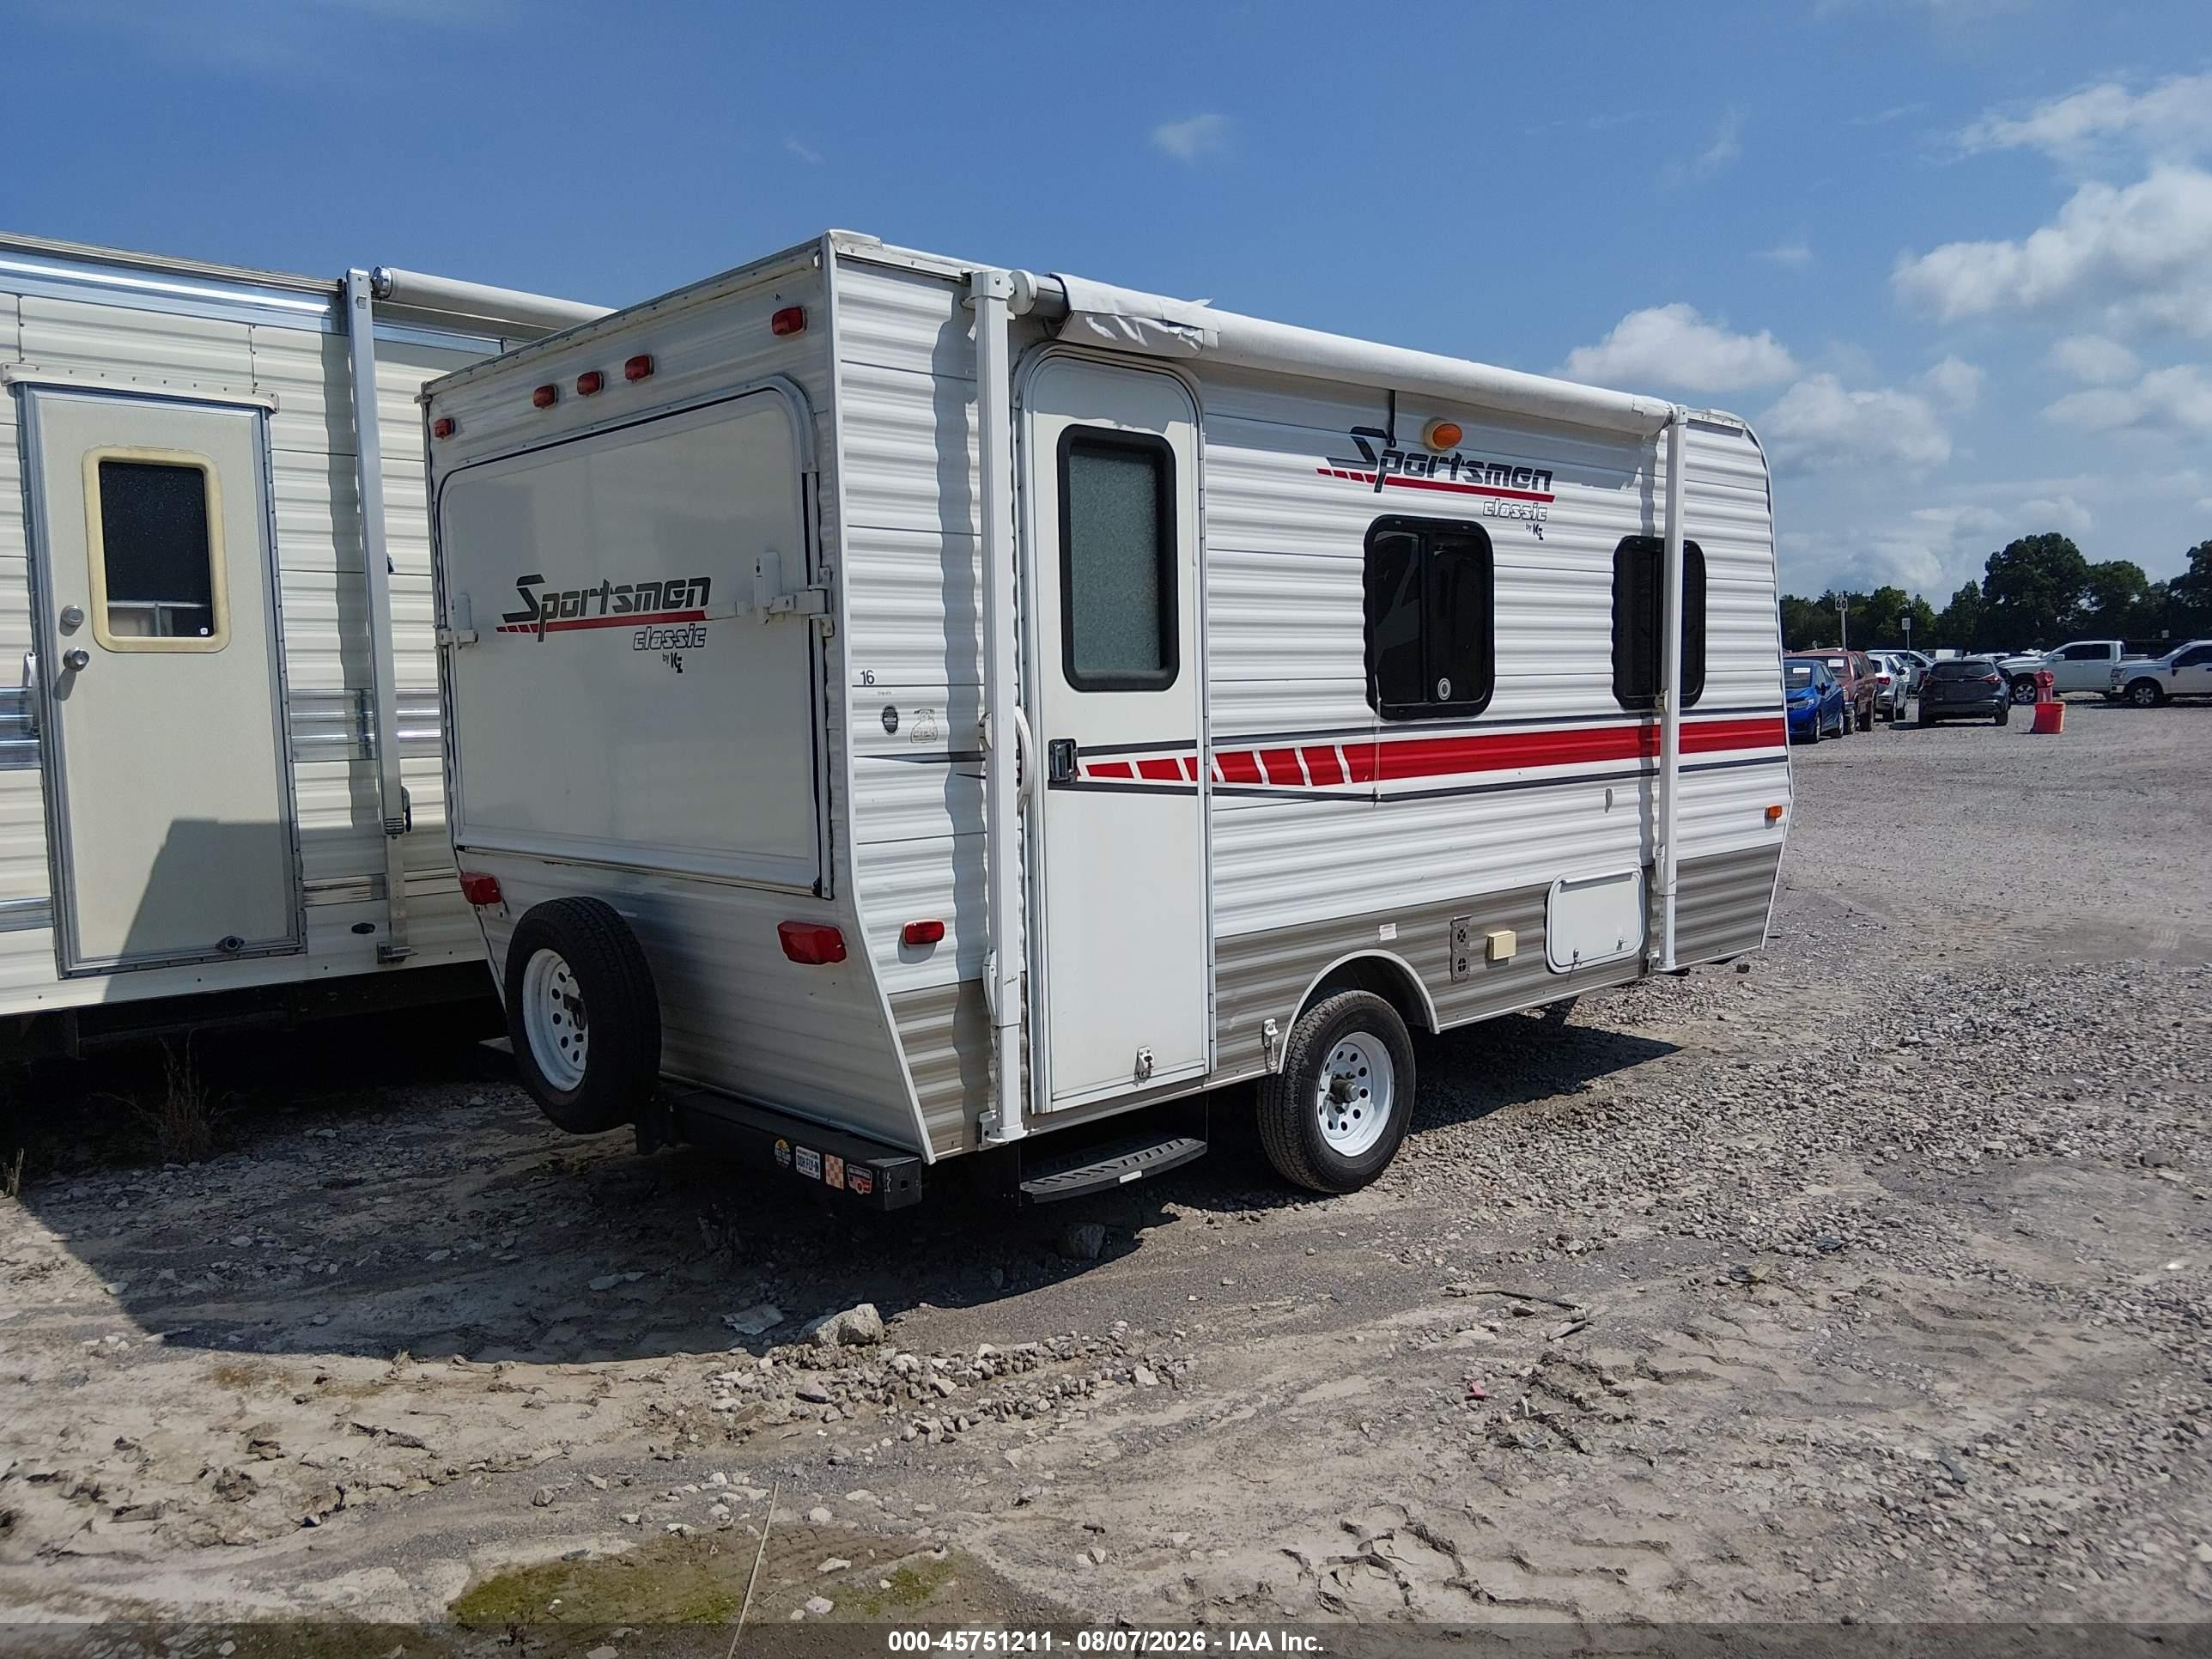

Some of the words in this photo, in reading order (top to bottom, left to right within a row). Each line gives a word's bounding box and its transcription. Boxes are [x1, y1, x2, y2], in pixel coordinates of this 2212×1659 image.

[1326, 426, 1553, 494] Sportsmen
[1482, 497, 1548, 522] classic
[1524, 523, 1532, 535] by
[501, 574, 712, 643] Sportsmen
[1835, 599, 1847, 609] 60
[632, 623, 707, 651] classic
[662, 653, 670, 665] by
[860, 670, 875, 685] 16
